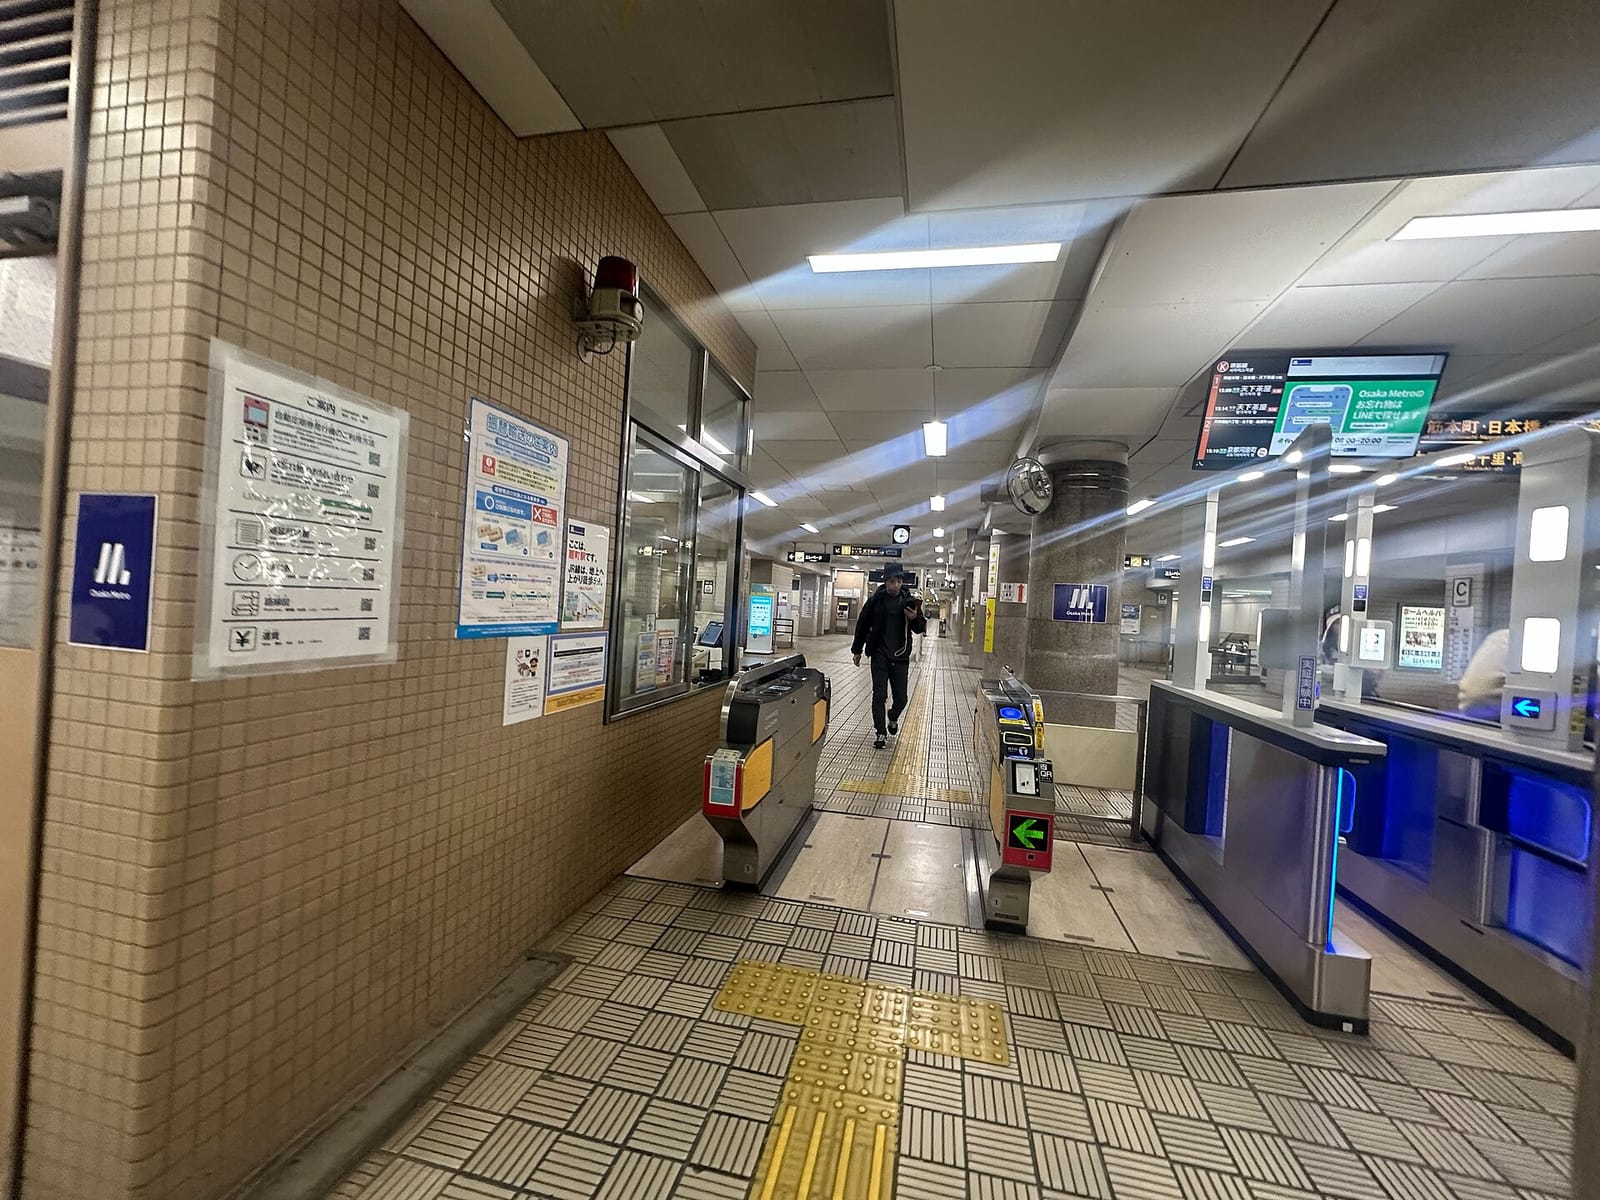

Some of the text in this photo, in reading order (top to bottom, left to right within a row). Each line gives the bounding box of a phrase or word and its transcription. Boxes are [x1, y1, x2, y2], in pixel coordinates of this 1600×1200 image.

[1358, 389, 1425, 398] Osaka Metroの
[306, 395, 337, 415] ご案内
[1356, 400, 1403, 409] お忘れ物は
[1352, 411, 1421, 420] LINEで探せます
[569, 540, 586, 551] ここは、
[1456, 581, 1467, 597] C
[1040, 770, 1053, 778] QR
